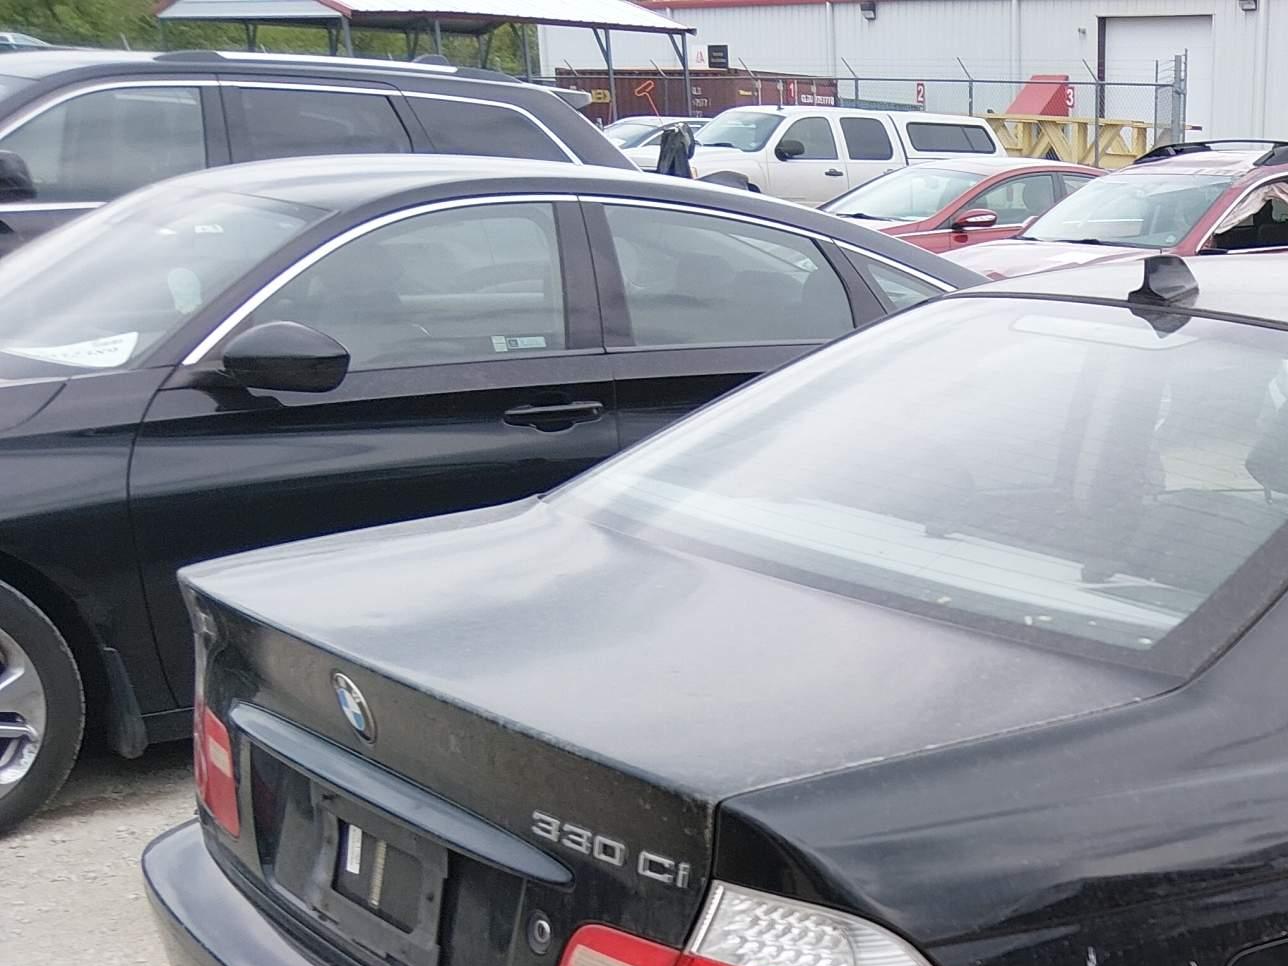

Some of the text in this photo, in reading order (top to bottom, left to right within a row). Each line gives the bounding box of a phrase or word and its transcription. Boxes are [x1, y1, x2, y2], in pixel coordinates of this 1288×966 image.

[789, 82, 795, 97] 1
[917, 85, 924, 101] 2
[1066, 89, 1074, 106] 3
[532, 810, 691, 889] 330 Ci
